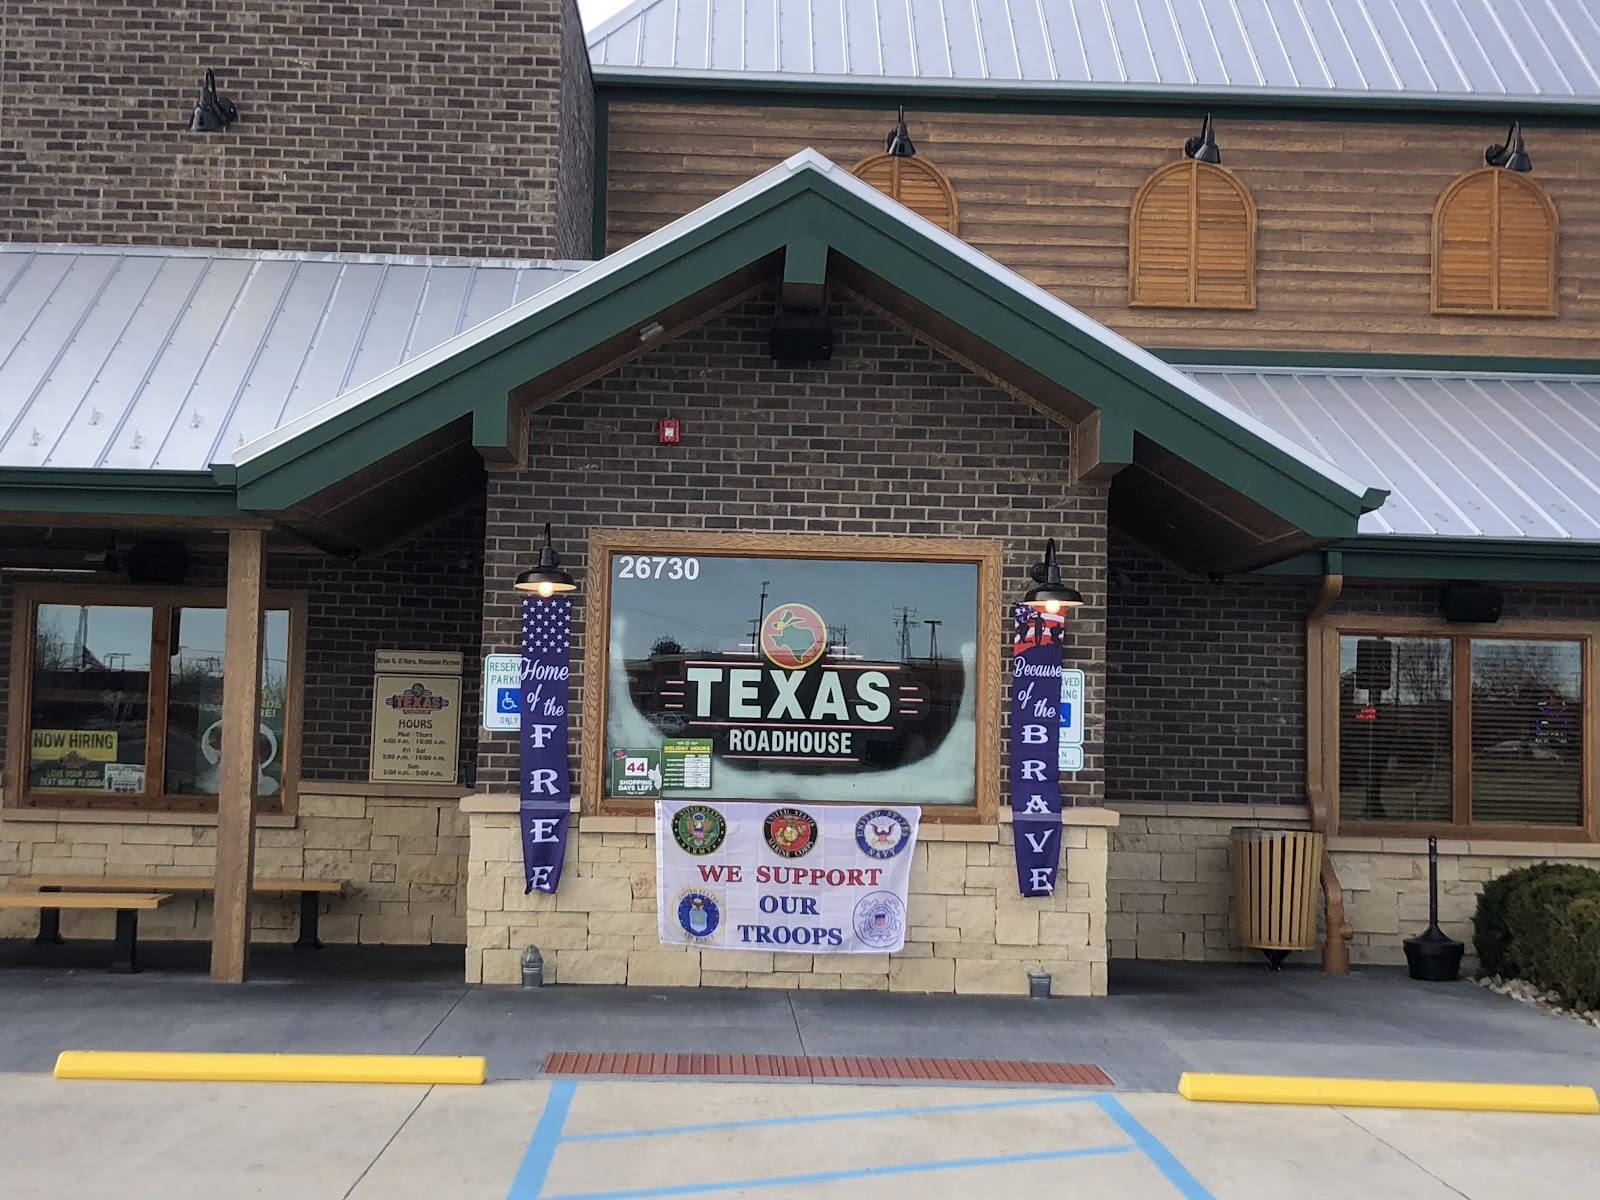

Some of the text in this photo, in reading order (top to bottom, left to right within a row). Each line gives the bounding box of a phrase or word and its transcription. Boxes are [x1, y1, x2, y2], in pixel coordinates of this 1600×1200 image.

[618, 556, 699, 580] 26730
[490, 662, 522, 672] RESERV
[521, 657, 569, 680] Home
[1013, 656, 1062, 677] Because
[491, 675, 521, 685] PARKI
[396, 695, 442, 709] TEXAS
[527, 684, 564, 716] of the
[687, 668, 891, 723] TEXAS
[1018, 682, 1034, 709] of
[1034, 698, 1056, 718] the
[260, 709, 276, 717] RE!
[399, 719, 433, 729] HOURS
[34, 733, 113, 749] NOW HIRING
[730, 729, 852, 754] ROADHOUSE
[47, 770, 64, 778] LOVE
[627, 762, 645, 772] 44
[530, 724, 560, 890] FREE
[766, 808, 814, 826] UNITED STATES
[1021, 724, 1054, 891] BRAVE
[856, 811, 908, 837] UNITED STATES
[768, 838, 814, 857] MARINE CORPS
[868, 848, 896, 858] NAVY
[697, 864, 882, 887] WE SUPPORT
[759, 895, 820, 916] OUR
[737, 924, 843, 946] TROOPS
